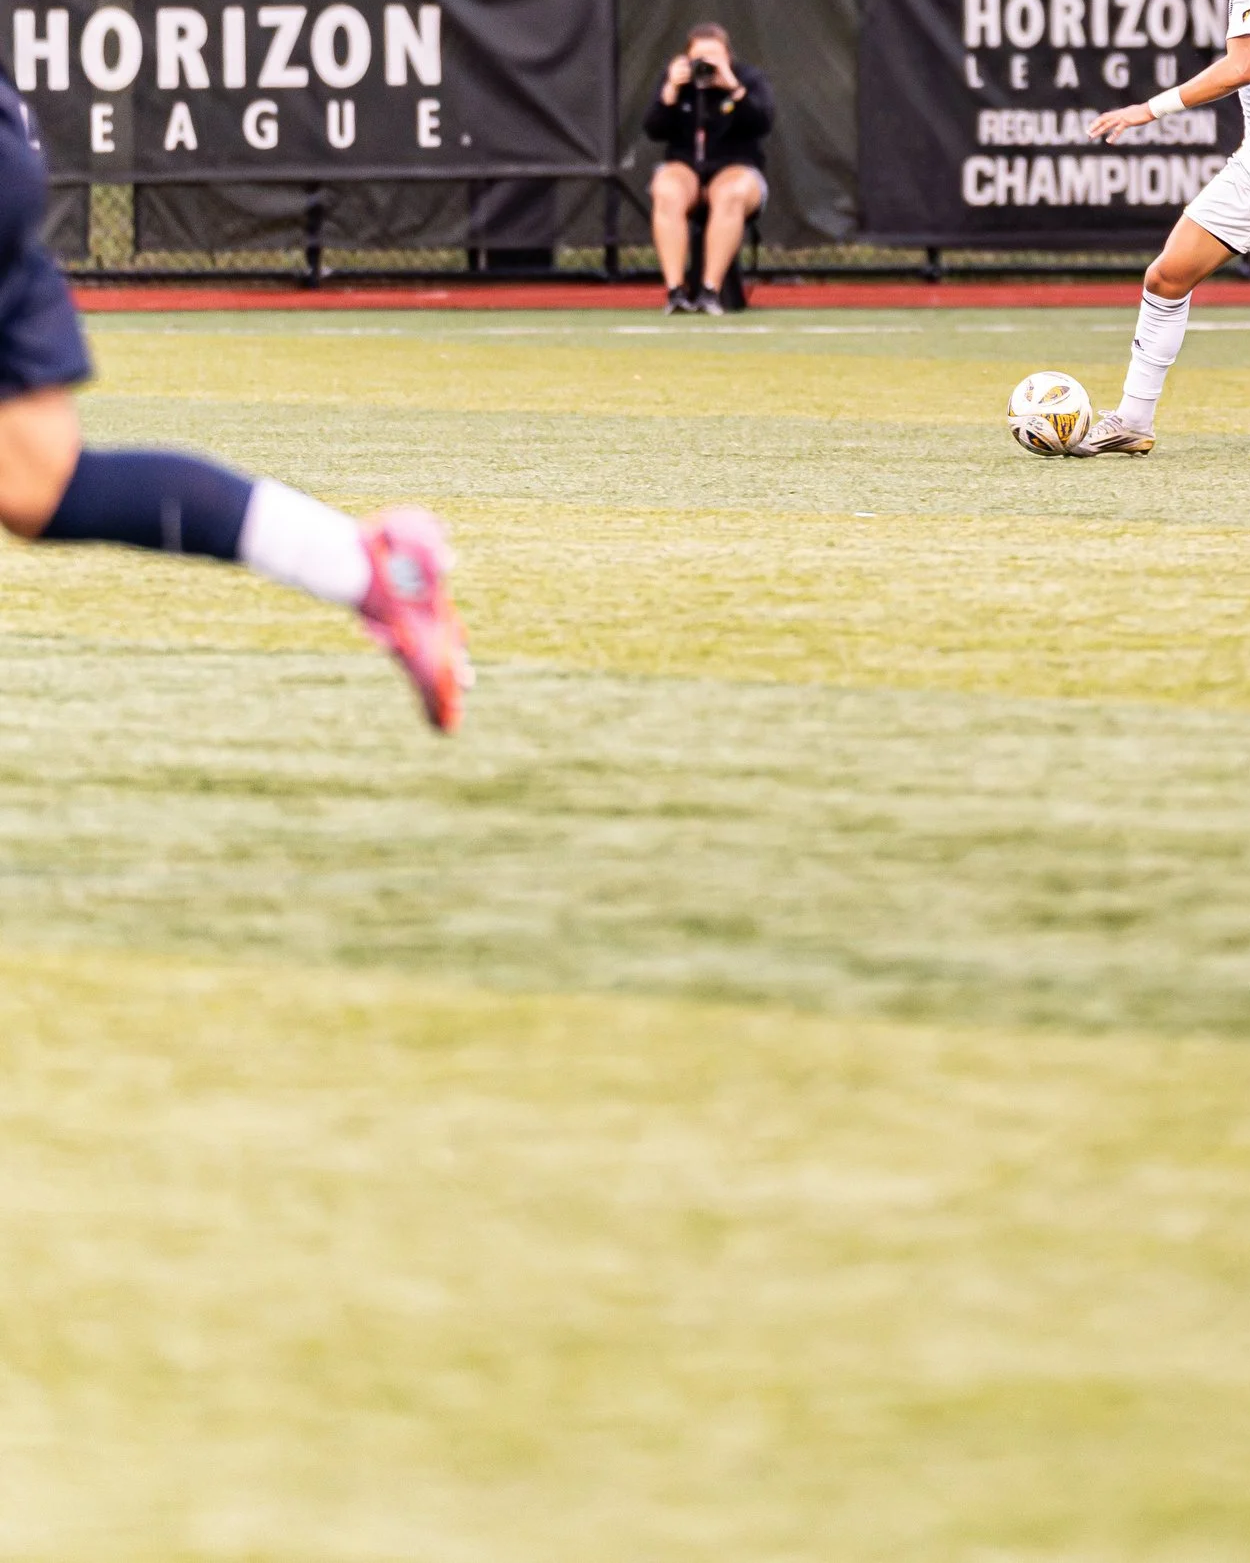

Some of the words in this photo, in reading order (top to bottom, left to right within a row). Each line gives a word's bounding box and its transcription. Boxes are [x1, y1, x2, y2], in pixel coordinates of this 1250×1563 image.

[13, 4, 442, 92] HORIZON
[964, 53, 1224, 89] LEAGU
[19, 99, 442, 153] EAGUE
